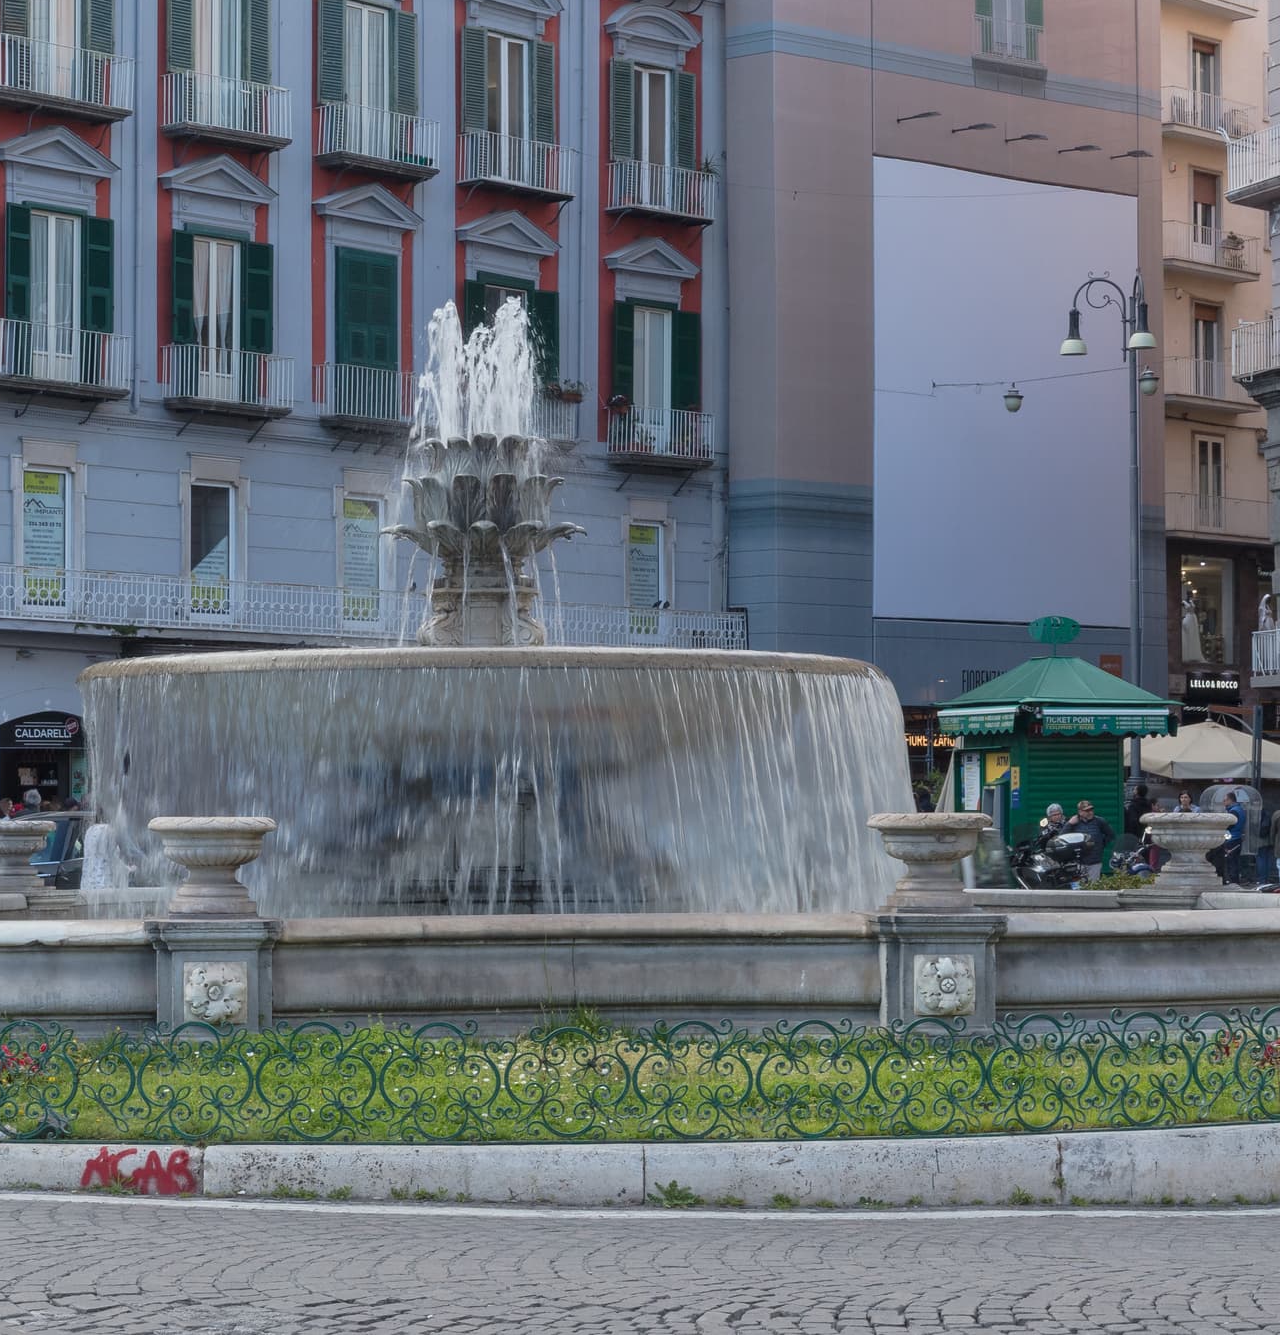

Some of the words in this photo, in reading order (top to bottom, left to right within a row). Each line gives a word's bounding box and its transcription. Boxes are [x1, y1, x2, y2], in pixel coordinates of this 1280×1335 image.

[1217, 680, 1238, 689] ROCCO
[1072, 716, 1094, 724] POINT
[997, 755, 1009, 767] ATM
